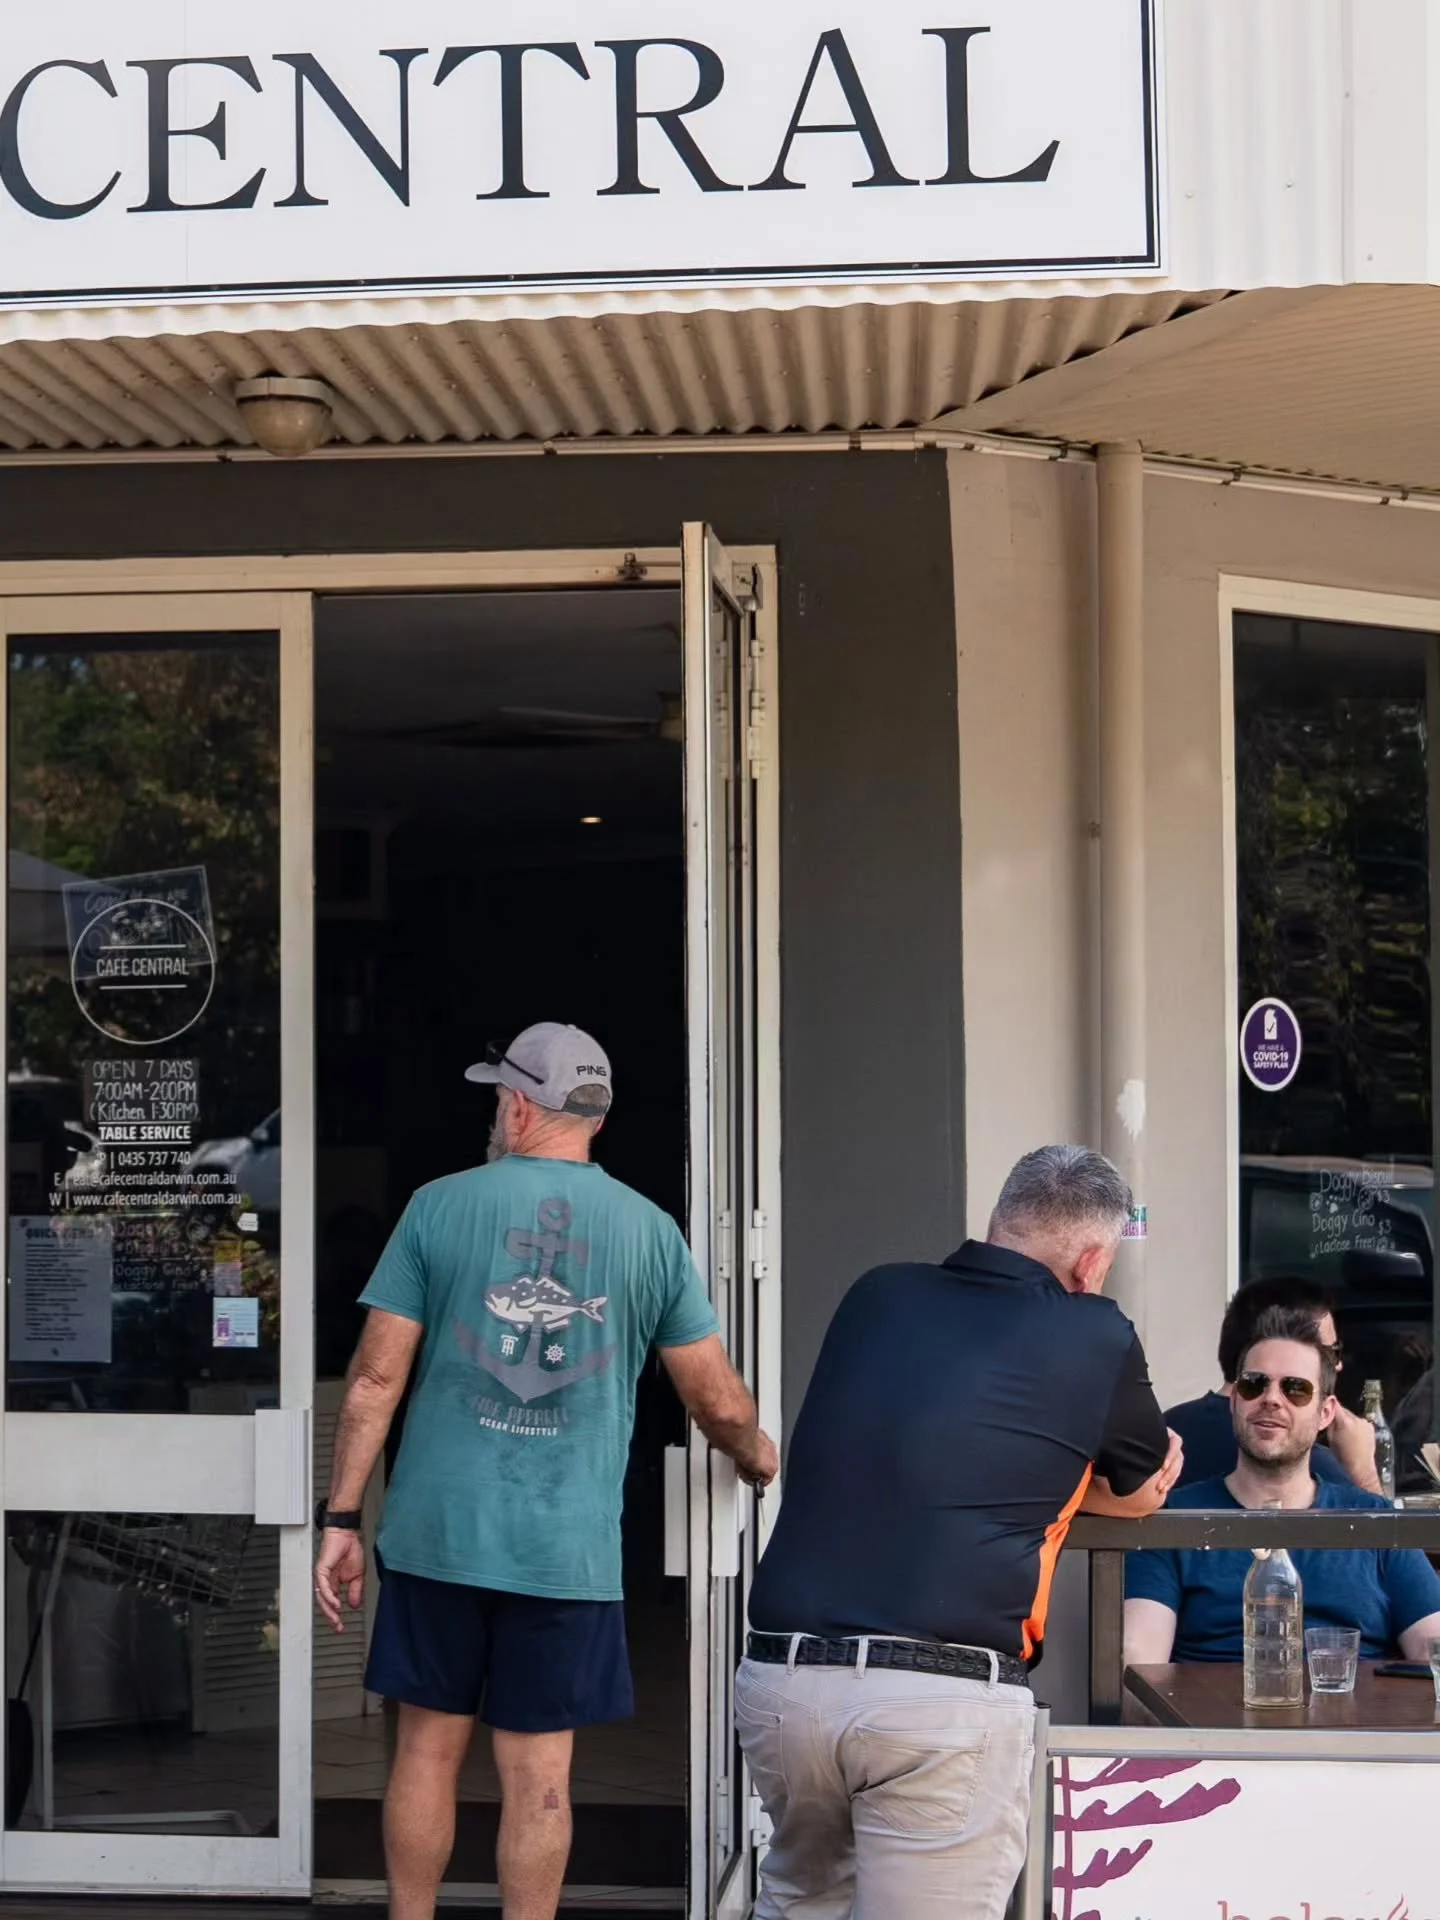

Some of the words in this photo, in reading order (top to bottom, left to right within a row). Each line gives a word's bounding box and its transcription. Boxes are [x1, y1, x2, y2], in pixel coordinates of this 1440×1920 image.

[0, 26, 1061, 220] CENTRAL
[96, 958, 129, 977] CAFE
[131, 957, 190, 977] CENTRAL
[1253, 1051, 1289, 1061] COVID-19
[92, 1060, 136, 1080] OPEN
[144, 1059, 155, 1078] 7
[160, 1059, 194, 1080] DAYS
[576, 1064, 607, 1077] PING
[1253, 1061, 1274, 1069] SAFETY
[1274, 1061, 1289, 1069] PLAN
[98, 1125, 137, 1140] TABLE
[140, 1125, 191, 1140] SERVICE
[118, 1152, 146, 1166] 0435
[149, 1151, 168, 1165] 737
[171, 1151, 192, 1165] 740
[54, 1172, 61, 1186] E
[49, 1192, 62, 1206] W
[72, 1191, 241, 1207] www.cafecentraldarwin.com.au
[1312, 1212, 1349, 1239] Doggy
[480, 1416, 508, 1433] OCEAN
[511, 1424, 558, 1437] LIFESTYLE
